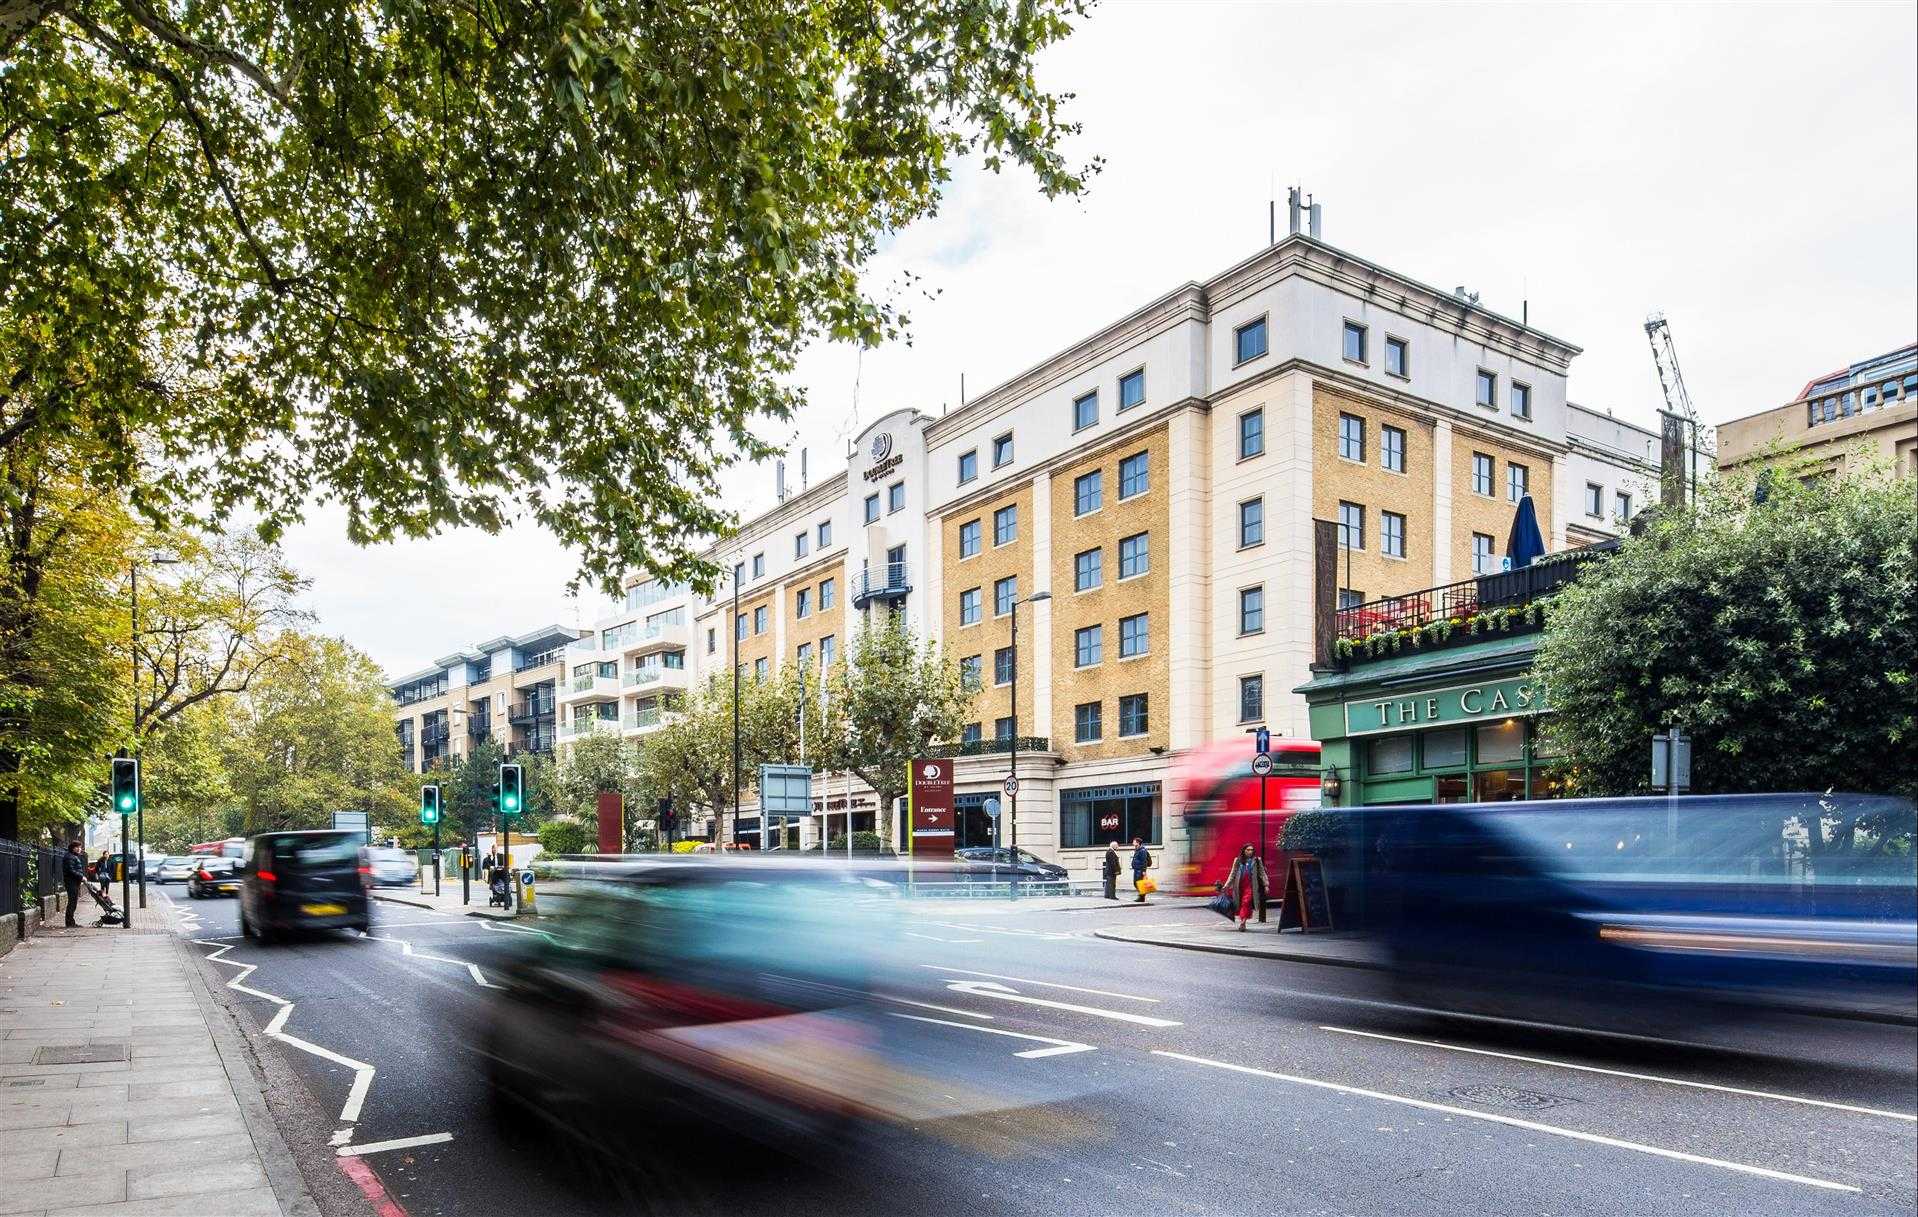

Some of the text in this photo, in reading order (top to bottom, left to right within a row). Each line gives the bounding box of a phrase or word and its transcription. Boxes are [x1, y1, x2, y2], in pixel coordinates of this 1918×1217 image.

[1375, 683, 1550, 725] THE CAS
[1006, 781, 1017, 791] 20
[1101, 818, 1119, 826] BAR
